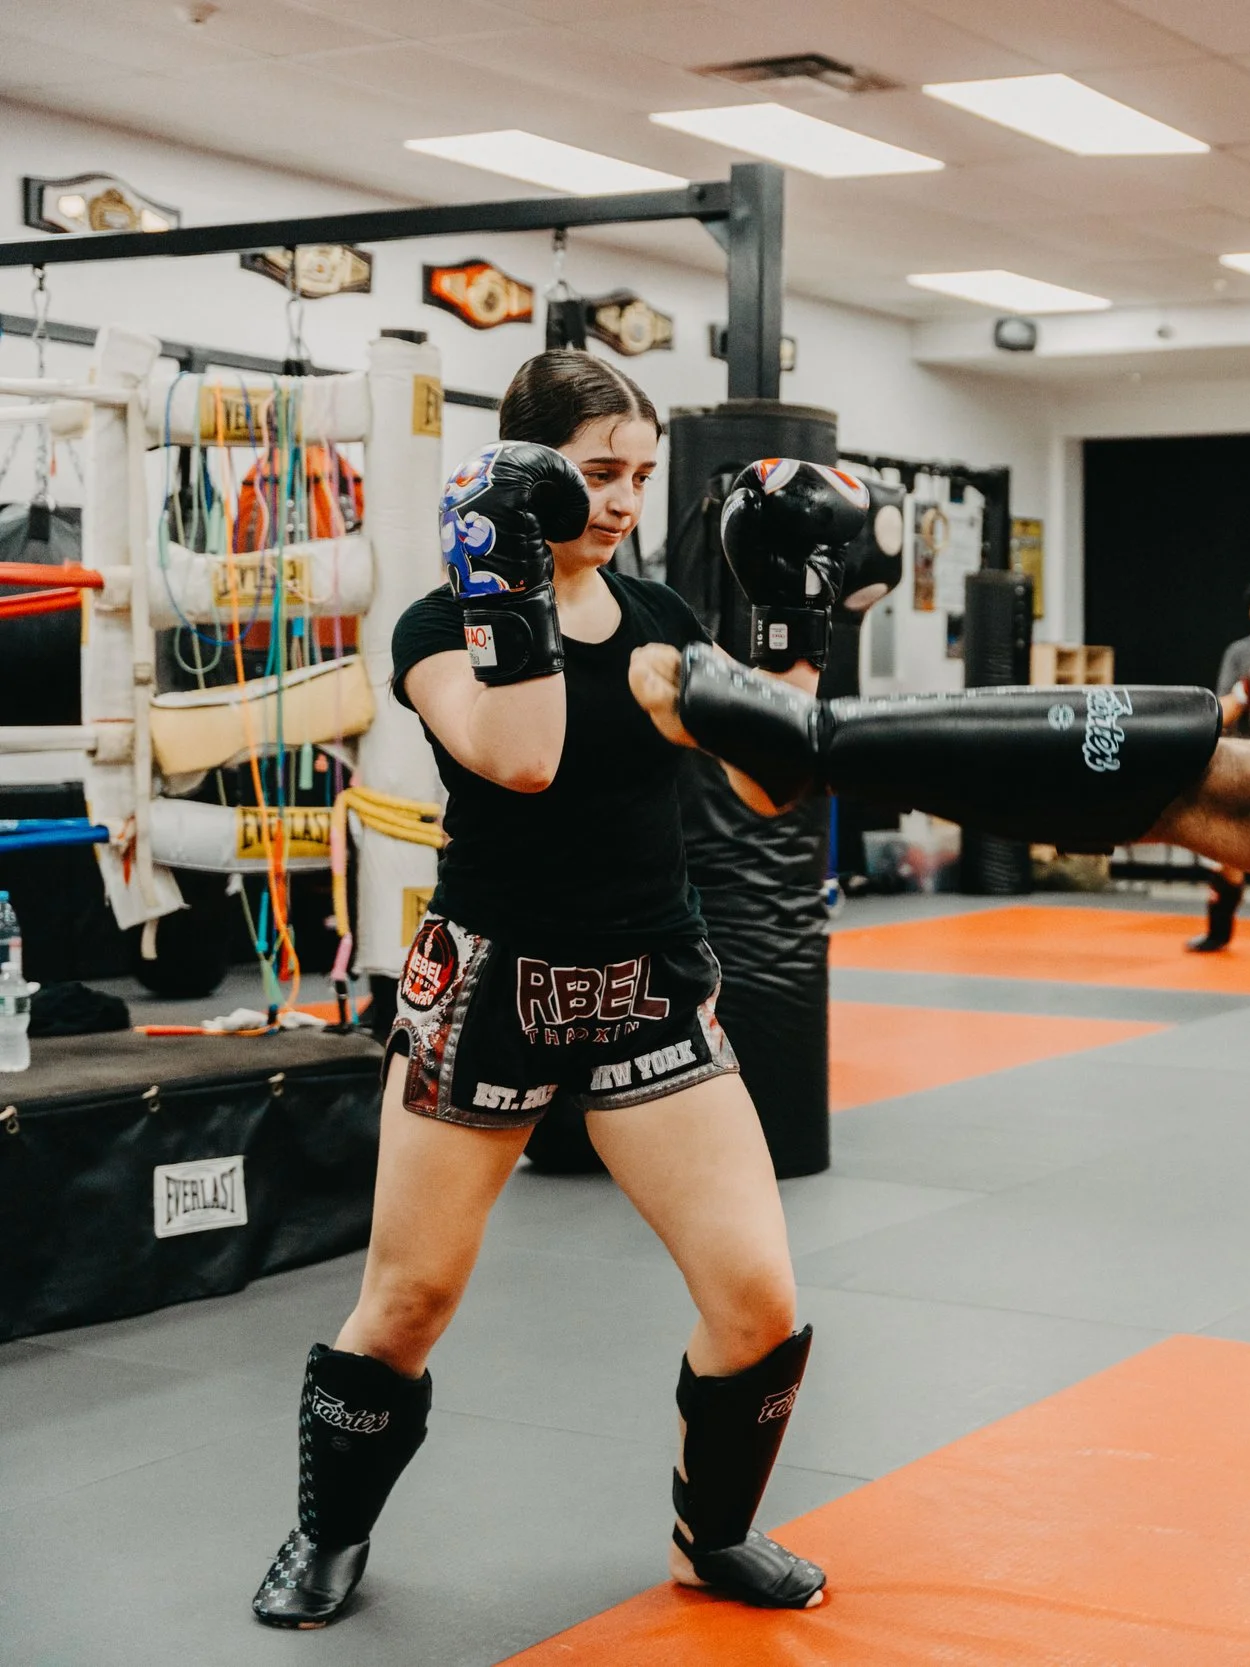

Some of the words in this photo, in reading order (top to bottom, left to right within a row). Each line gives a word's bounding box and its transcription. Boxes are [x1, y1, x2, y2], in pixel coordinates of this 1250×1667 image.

[634, 1039, 698, 1081] YORK
[165, 1166, 236, 1225] EVERLAST
[312, 1385, 389, 1434] Fairtex
